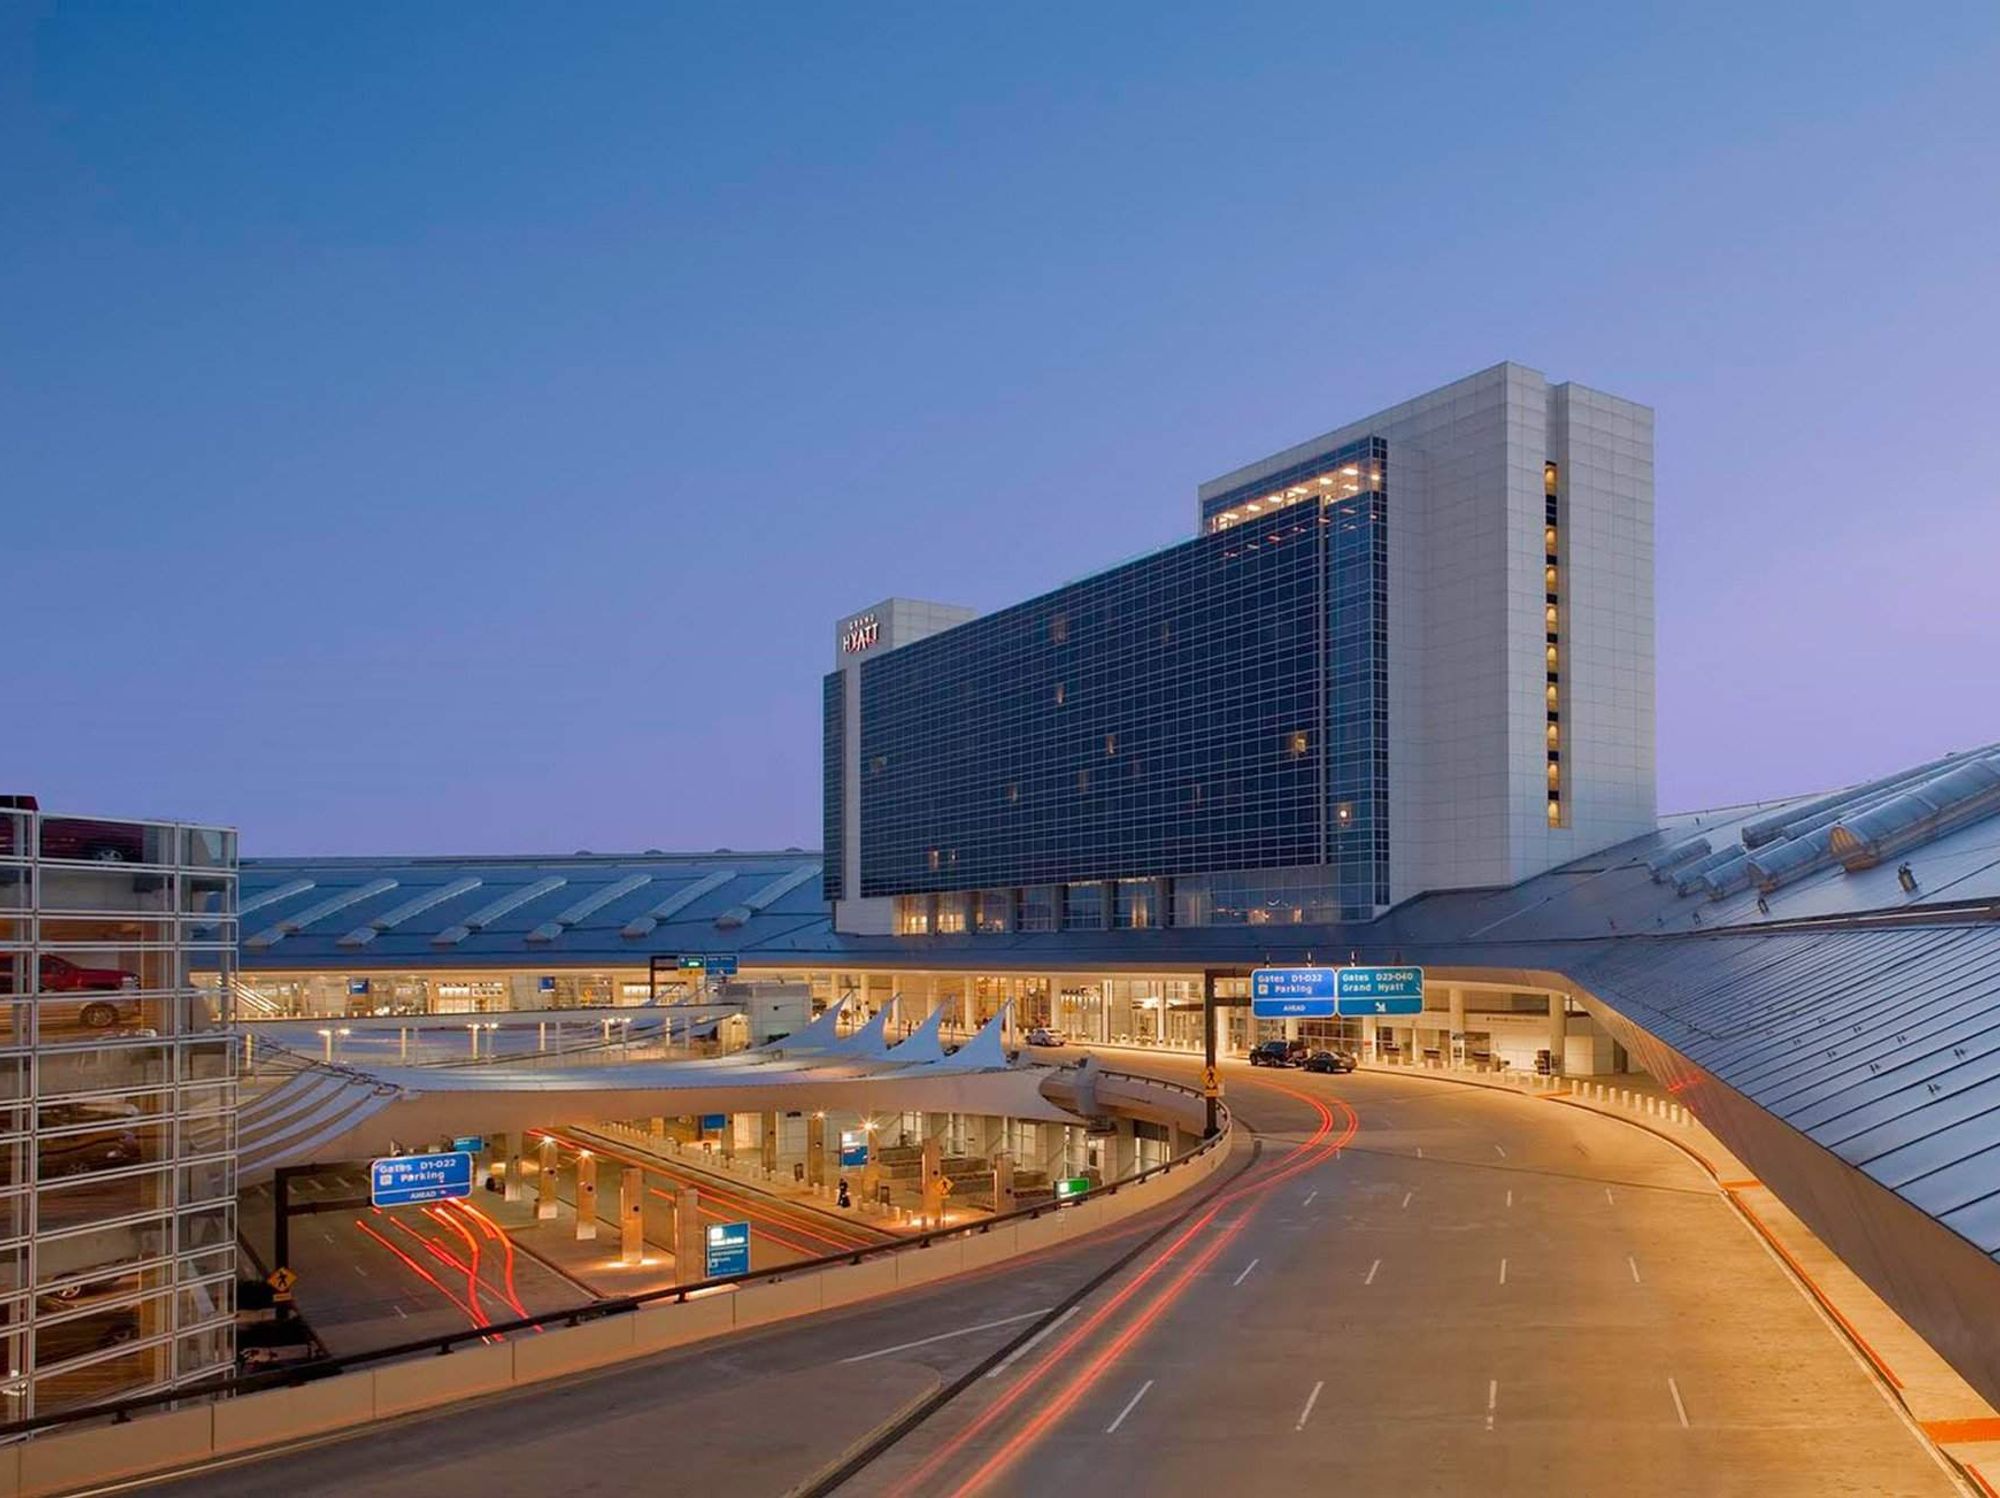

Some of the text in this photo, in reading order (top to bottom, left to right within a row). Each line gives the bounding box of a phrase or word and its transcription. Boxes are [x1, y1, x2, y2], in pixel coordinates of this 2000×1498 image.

[843, 623, 878, 652] HYATT
[1257, 975, 1285, 983] Gates
[1342, 973, 1370, 982] Gates
[1275, 985, 1313, 995] Parking
[1342, 983, 1404, 993] Grand Hyatt
[1283, 1004, 1306, 1012] AHEAD
[379, 1164, 412, 1173] Gates
[400, 1171, 445, 1183] Parking
[410, 1190, 437, 1200] AHEAD
